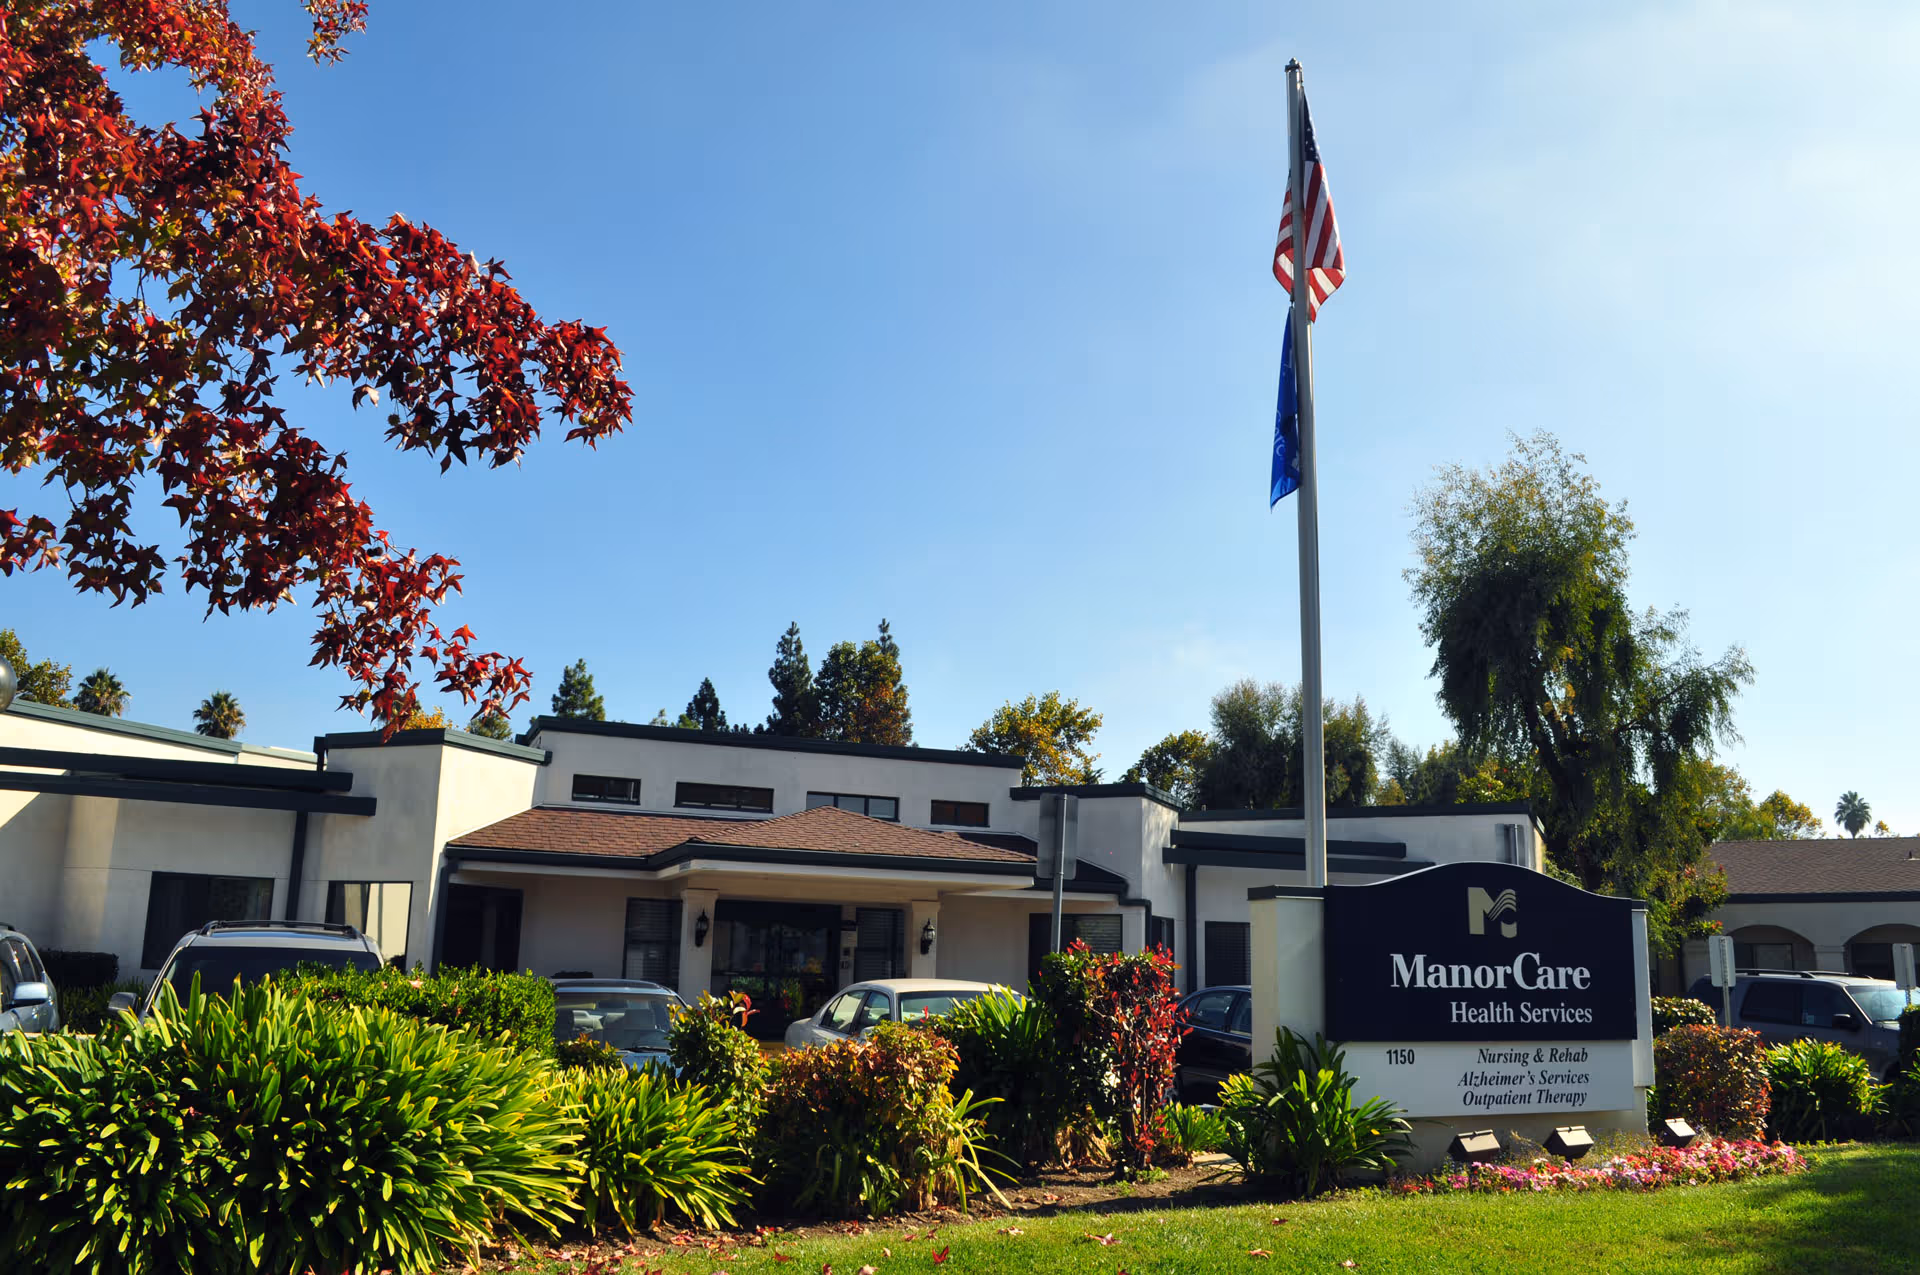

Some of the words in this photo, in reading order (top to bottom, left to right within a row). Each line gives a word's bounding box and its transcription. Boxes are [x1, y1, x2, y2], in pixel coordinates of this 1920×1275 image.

[1390, 952, 1591, 990] ManorCare
[1450, 1001, 1514, 1023] Health
[1520, 1002, 1593, 1023] Services
[1386, 1048, 1415, 1065] 1150
[1477, 1048, 1530, 1067] Nursing
[1533, 1047, 1545, 1063] &
[1549, 1047, 1588, 1063] Rehab
[1458, 1070, 1536, 1087] Alzheimer's
[1538, 1069, 1590, 1085] Services
[1463, 1090, 1532, 1110] Outpatient
[1536, 1088, 1588, 1107] Therapy
